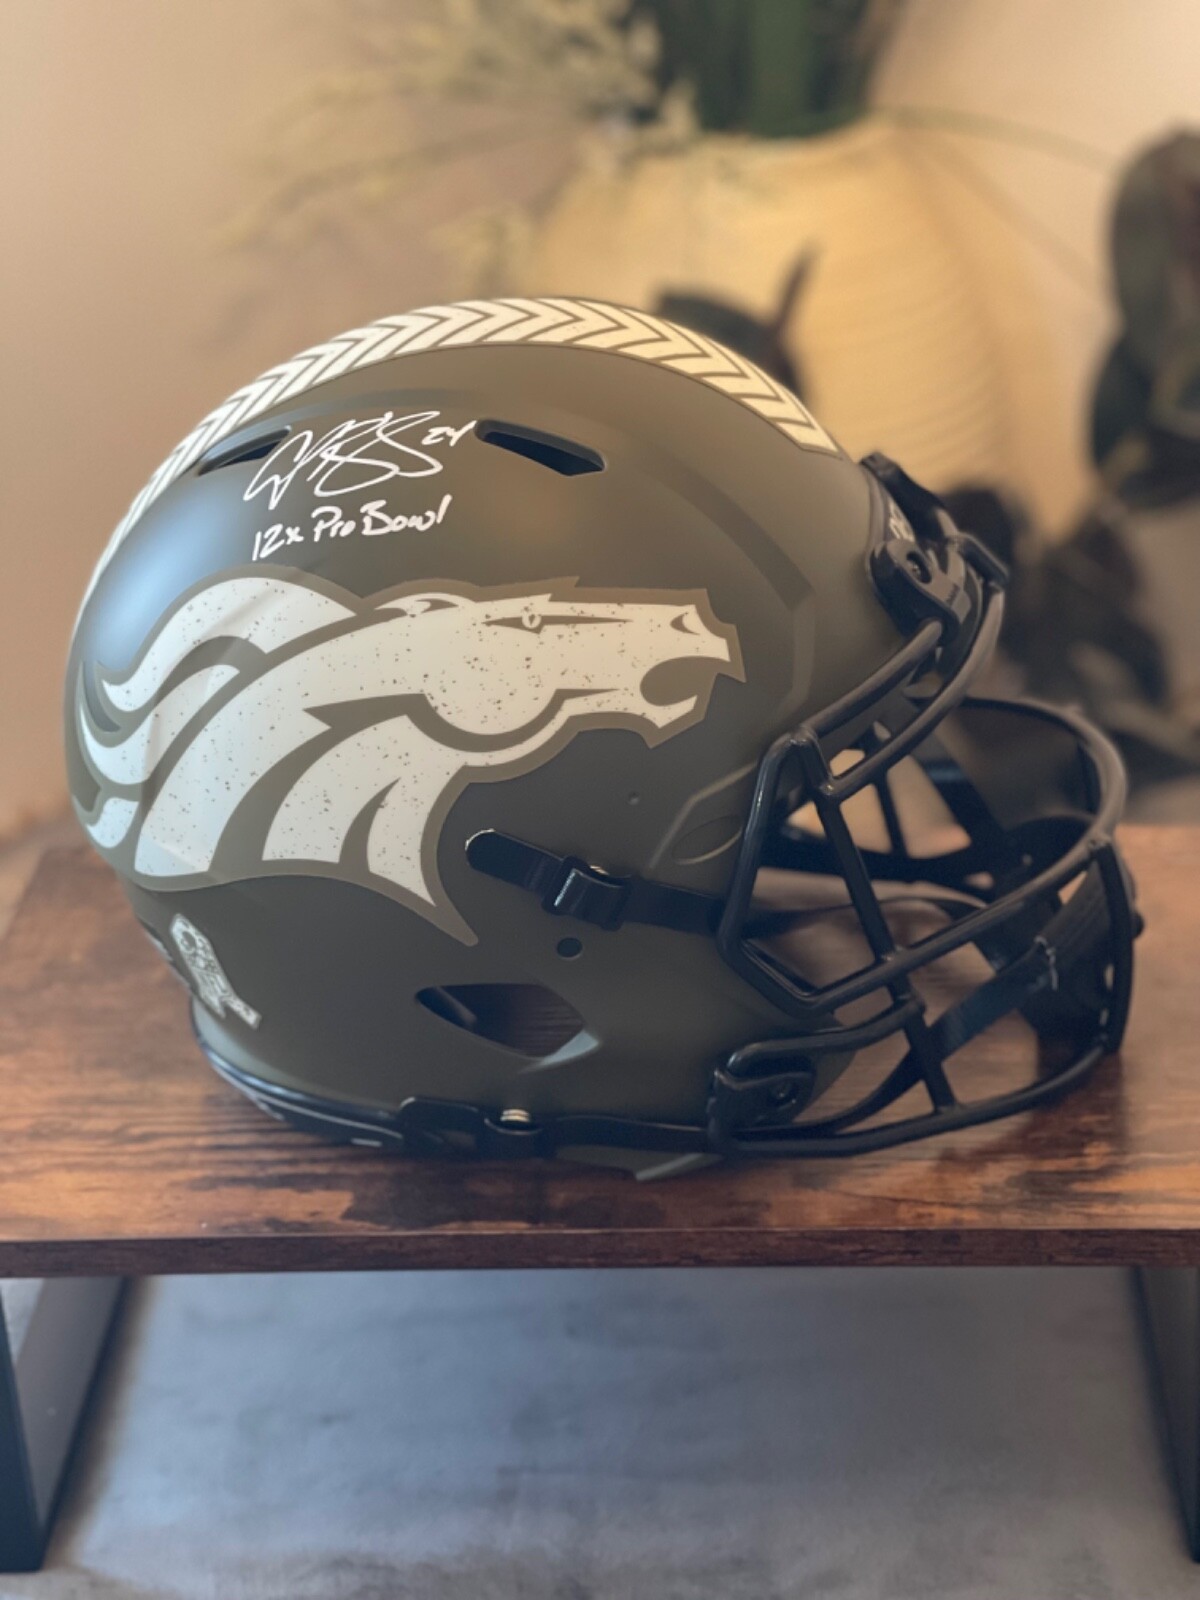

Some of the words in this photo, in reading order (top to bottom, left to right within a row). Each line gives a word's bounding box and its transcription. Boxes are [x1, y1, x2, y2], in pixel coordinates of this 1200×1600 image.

[252, 524, 304, 561] 12x
[311, 506, 357, 542] Pro
[360, 494, 452, 536] Bowl
